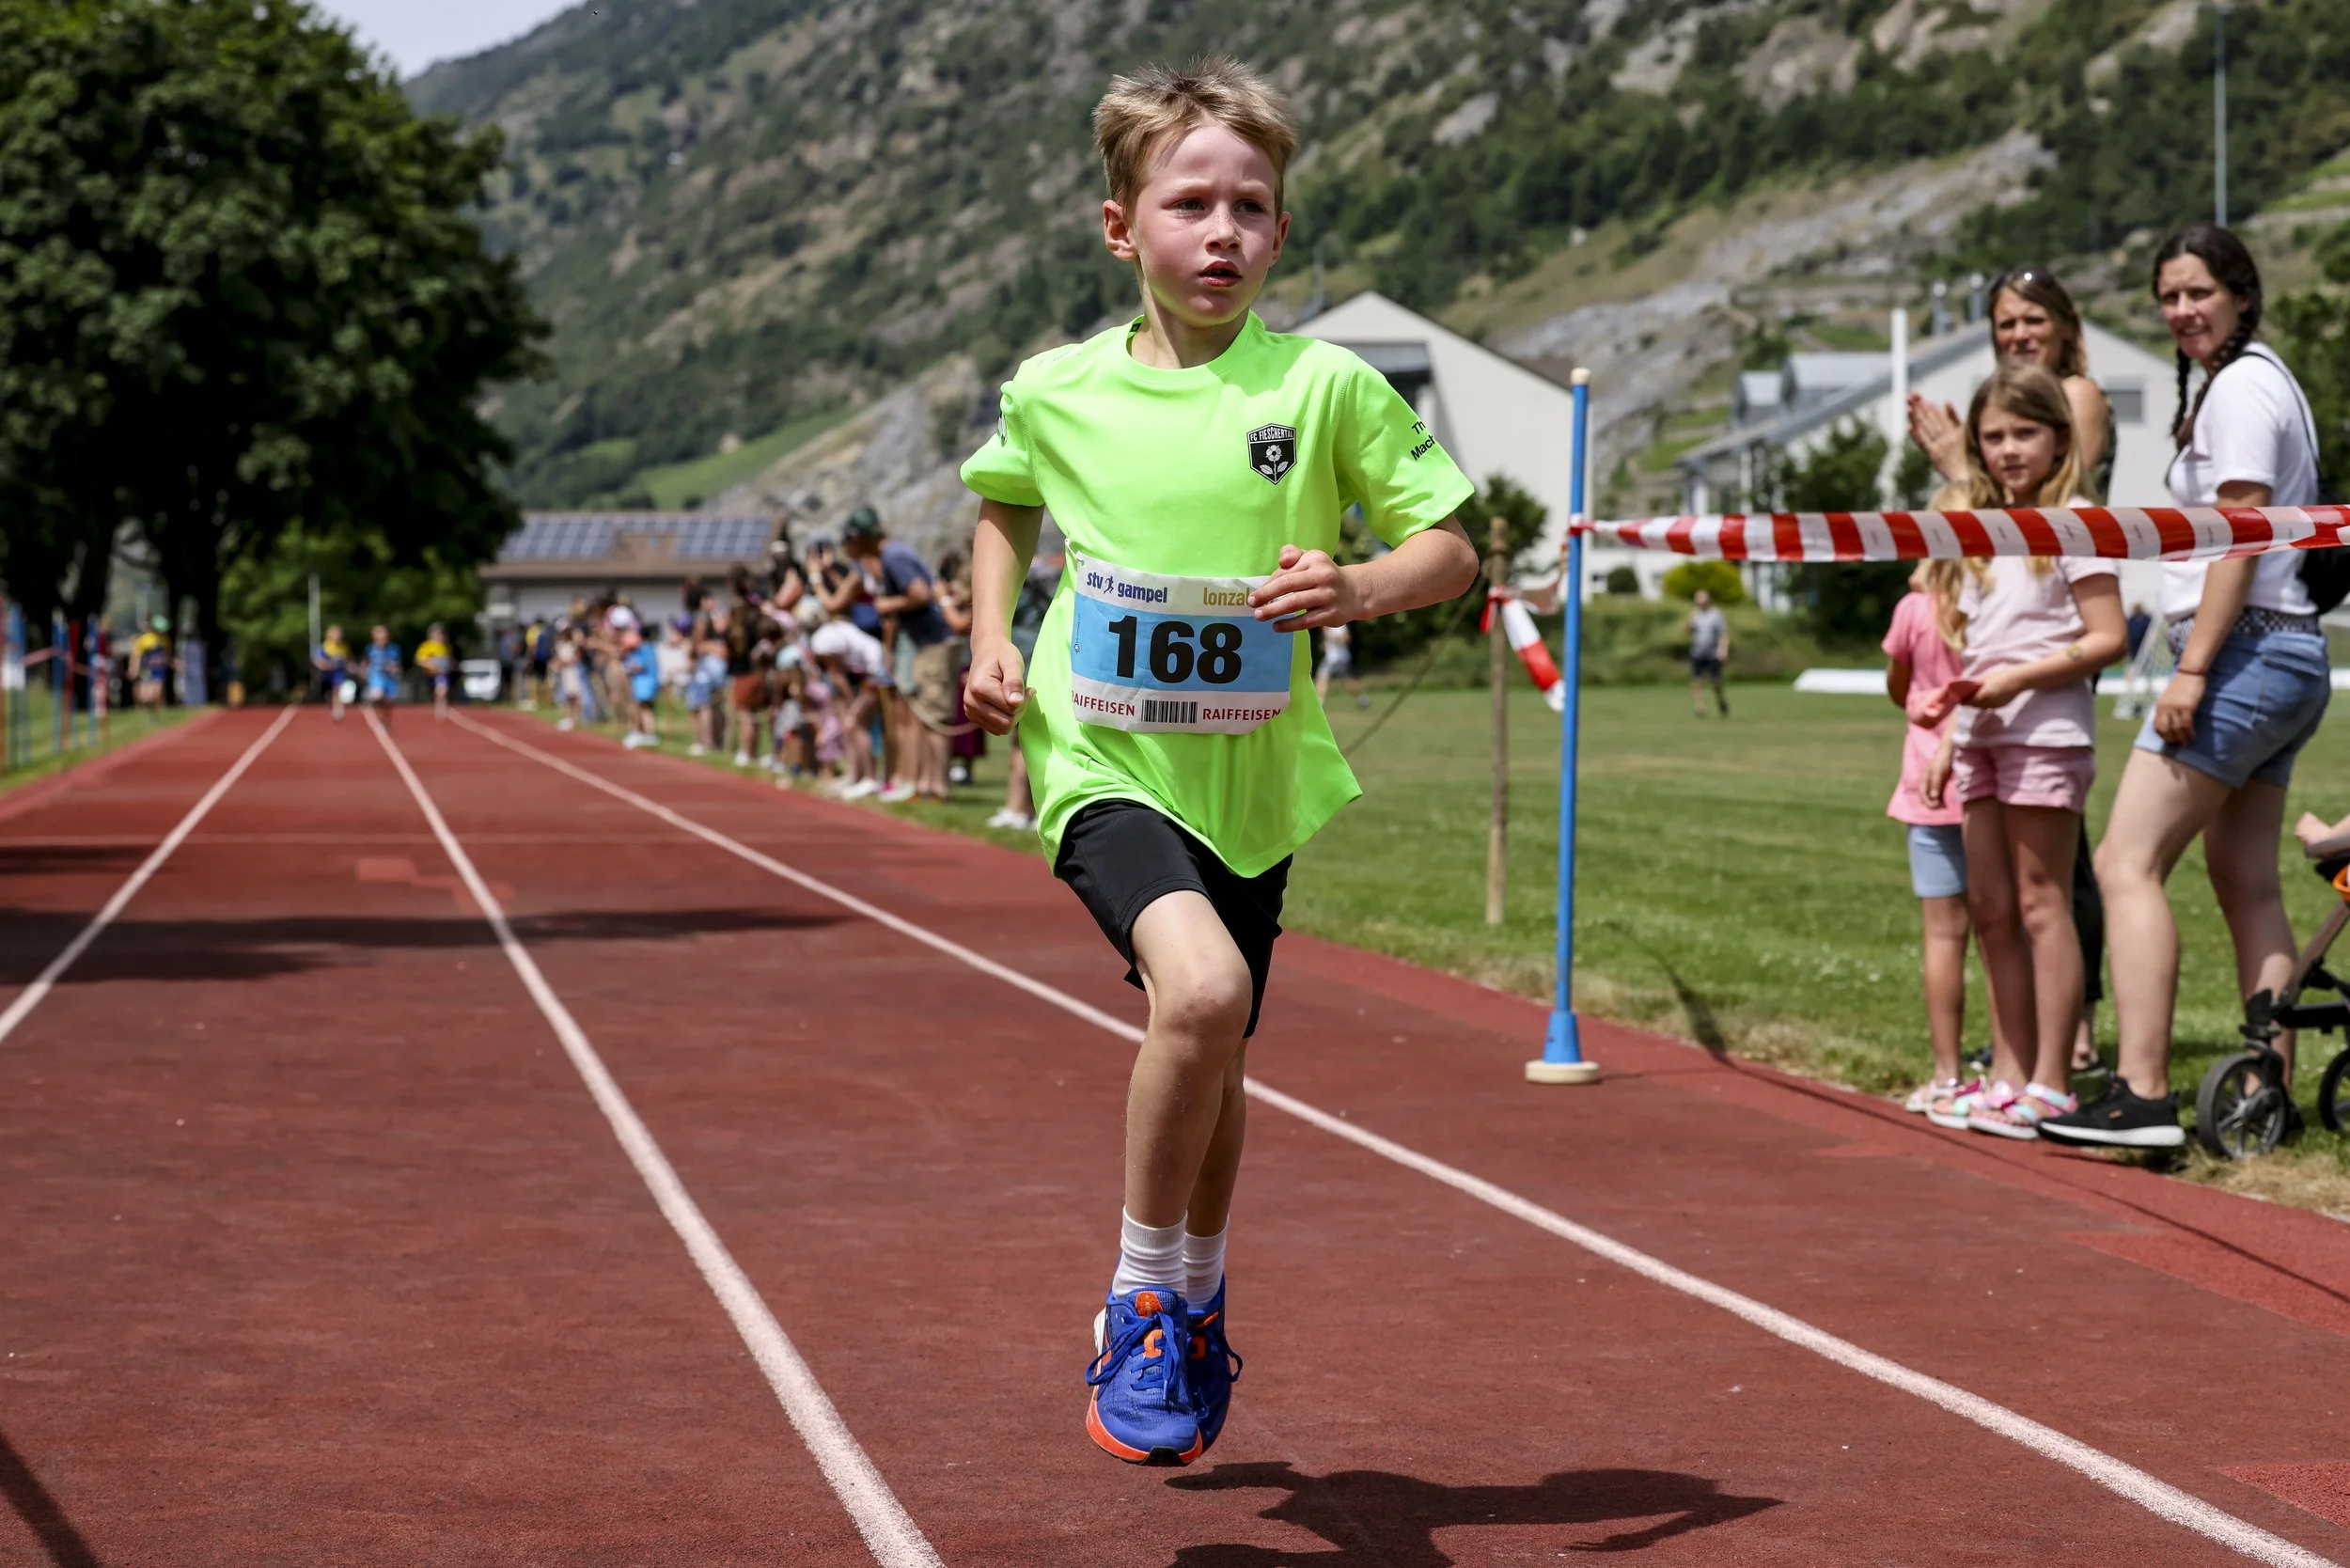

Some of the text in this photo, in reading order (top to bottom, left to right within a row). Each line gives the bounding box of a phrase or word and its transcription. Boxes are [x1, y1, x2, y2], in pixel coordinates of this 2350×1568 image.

[1087, 572, 1167, 603] stv gampel
[1108, 615, 1243, 684] 168
[1202, 708, 1281, 721] RAIFFEISEN
